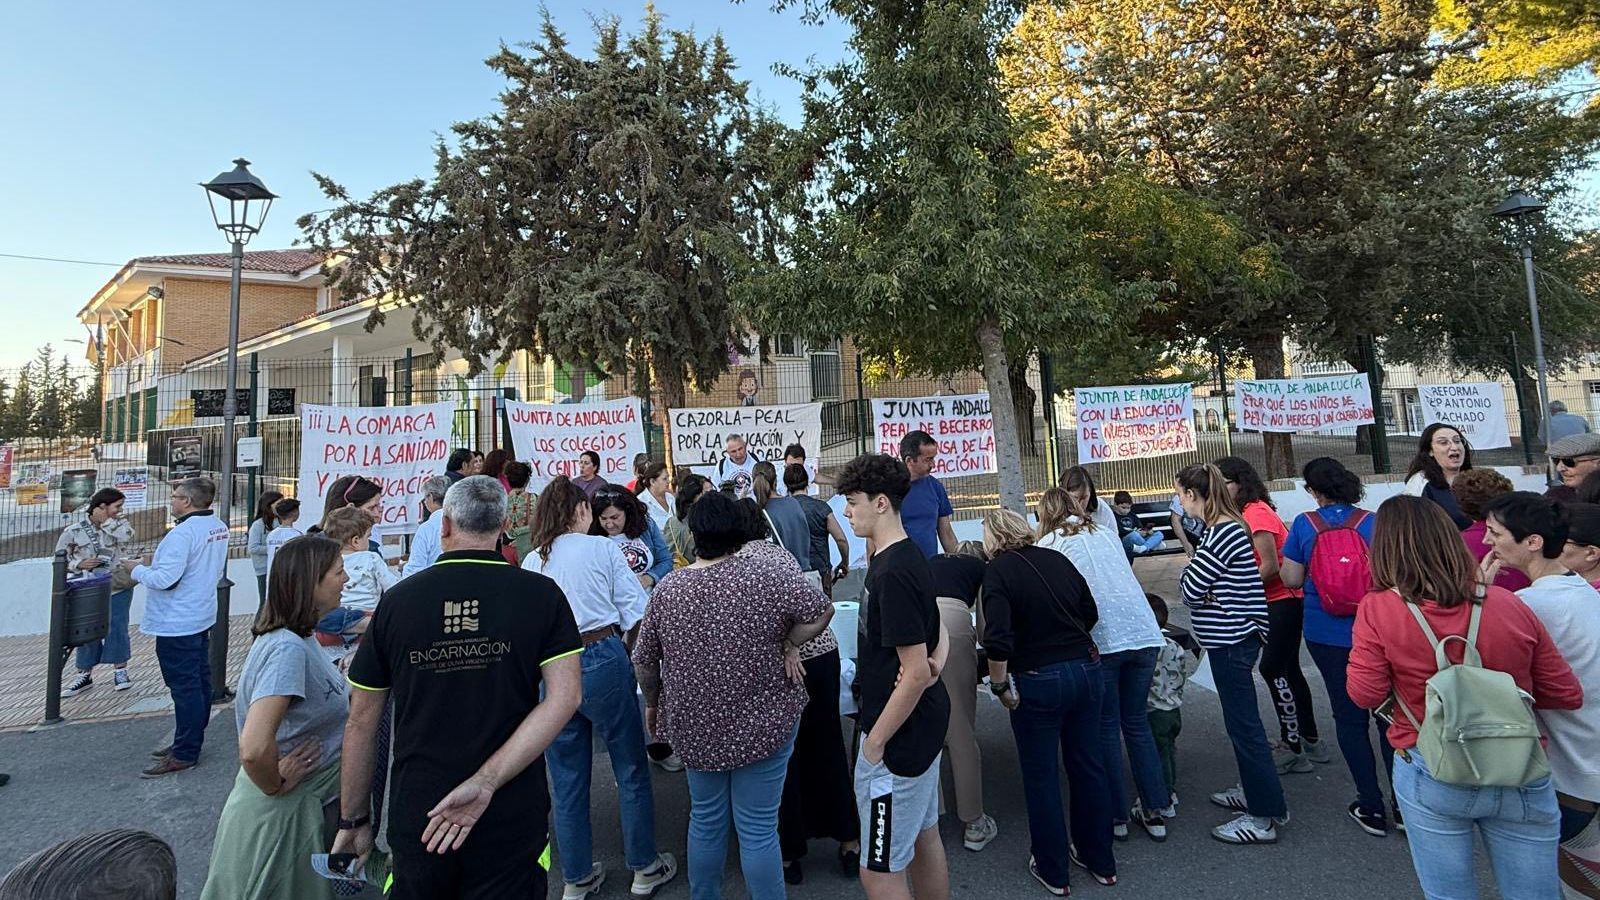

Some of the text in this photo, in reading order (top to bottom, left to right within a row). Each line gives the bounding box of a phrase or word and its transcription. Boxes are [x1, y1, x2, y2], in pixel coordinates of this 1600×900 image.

[1243, 382, 1281, 395] JUNTA
[1287, 383, 1299, 394] DE
[1431, 386, 1479, 397] REFORMA
[1079, 391, 1120, 405] JUNTA
[1124, 390, 1138, 401] DE
[1290, 399, 1308, 411] LOS
[1310, 396, 1339, 410] NIÑOS
[1342, 396, 1356, 406] DE
[1445, 398, 1492, 408] ANTONIO
[512, 407, 553, 425] JUNTA
[556, 412, 572, 427] DE
[883, 401, 944, 419] JUNTA
[1081, 409, 1105, 422] CON
[1110, 406, 1121, 420] LA
[326, 415, 351, 435] LA
[356, 411, 436, 435] COMARCA
[940, 419, 993, 434] BECERRO
[1270, 413, 1283, 426] NO
[1083, 428, 1098, 440] DE
[1104, 423, 1156, 439] NUESTROS
[534, 430, 627, 452] LOS COLEGIOS
[678, 433, 702, 451] POR
[706, 433, 722, 449] LA
[963, 439, 975, 453] DE
[979, 436, 994, 452] LA
[324, 436, 447, 467] POR LA SANIDAD
[702, 450, 719, 463] LA
[1091, 444, 1111, 459] NO
[1118, 442, 1138, 457] SE
[531, 456, 627, 477] Y CENT DE
[316, 470, 330, 498] Y
[1273, 677, 1299, 743] adidas
